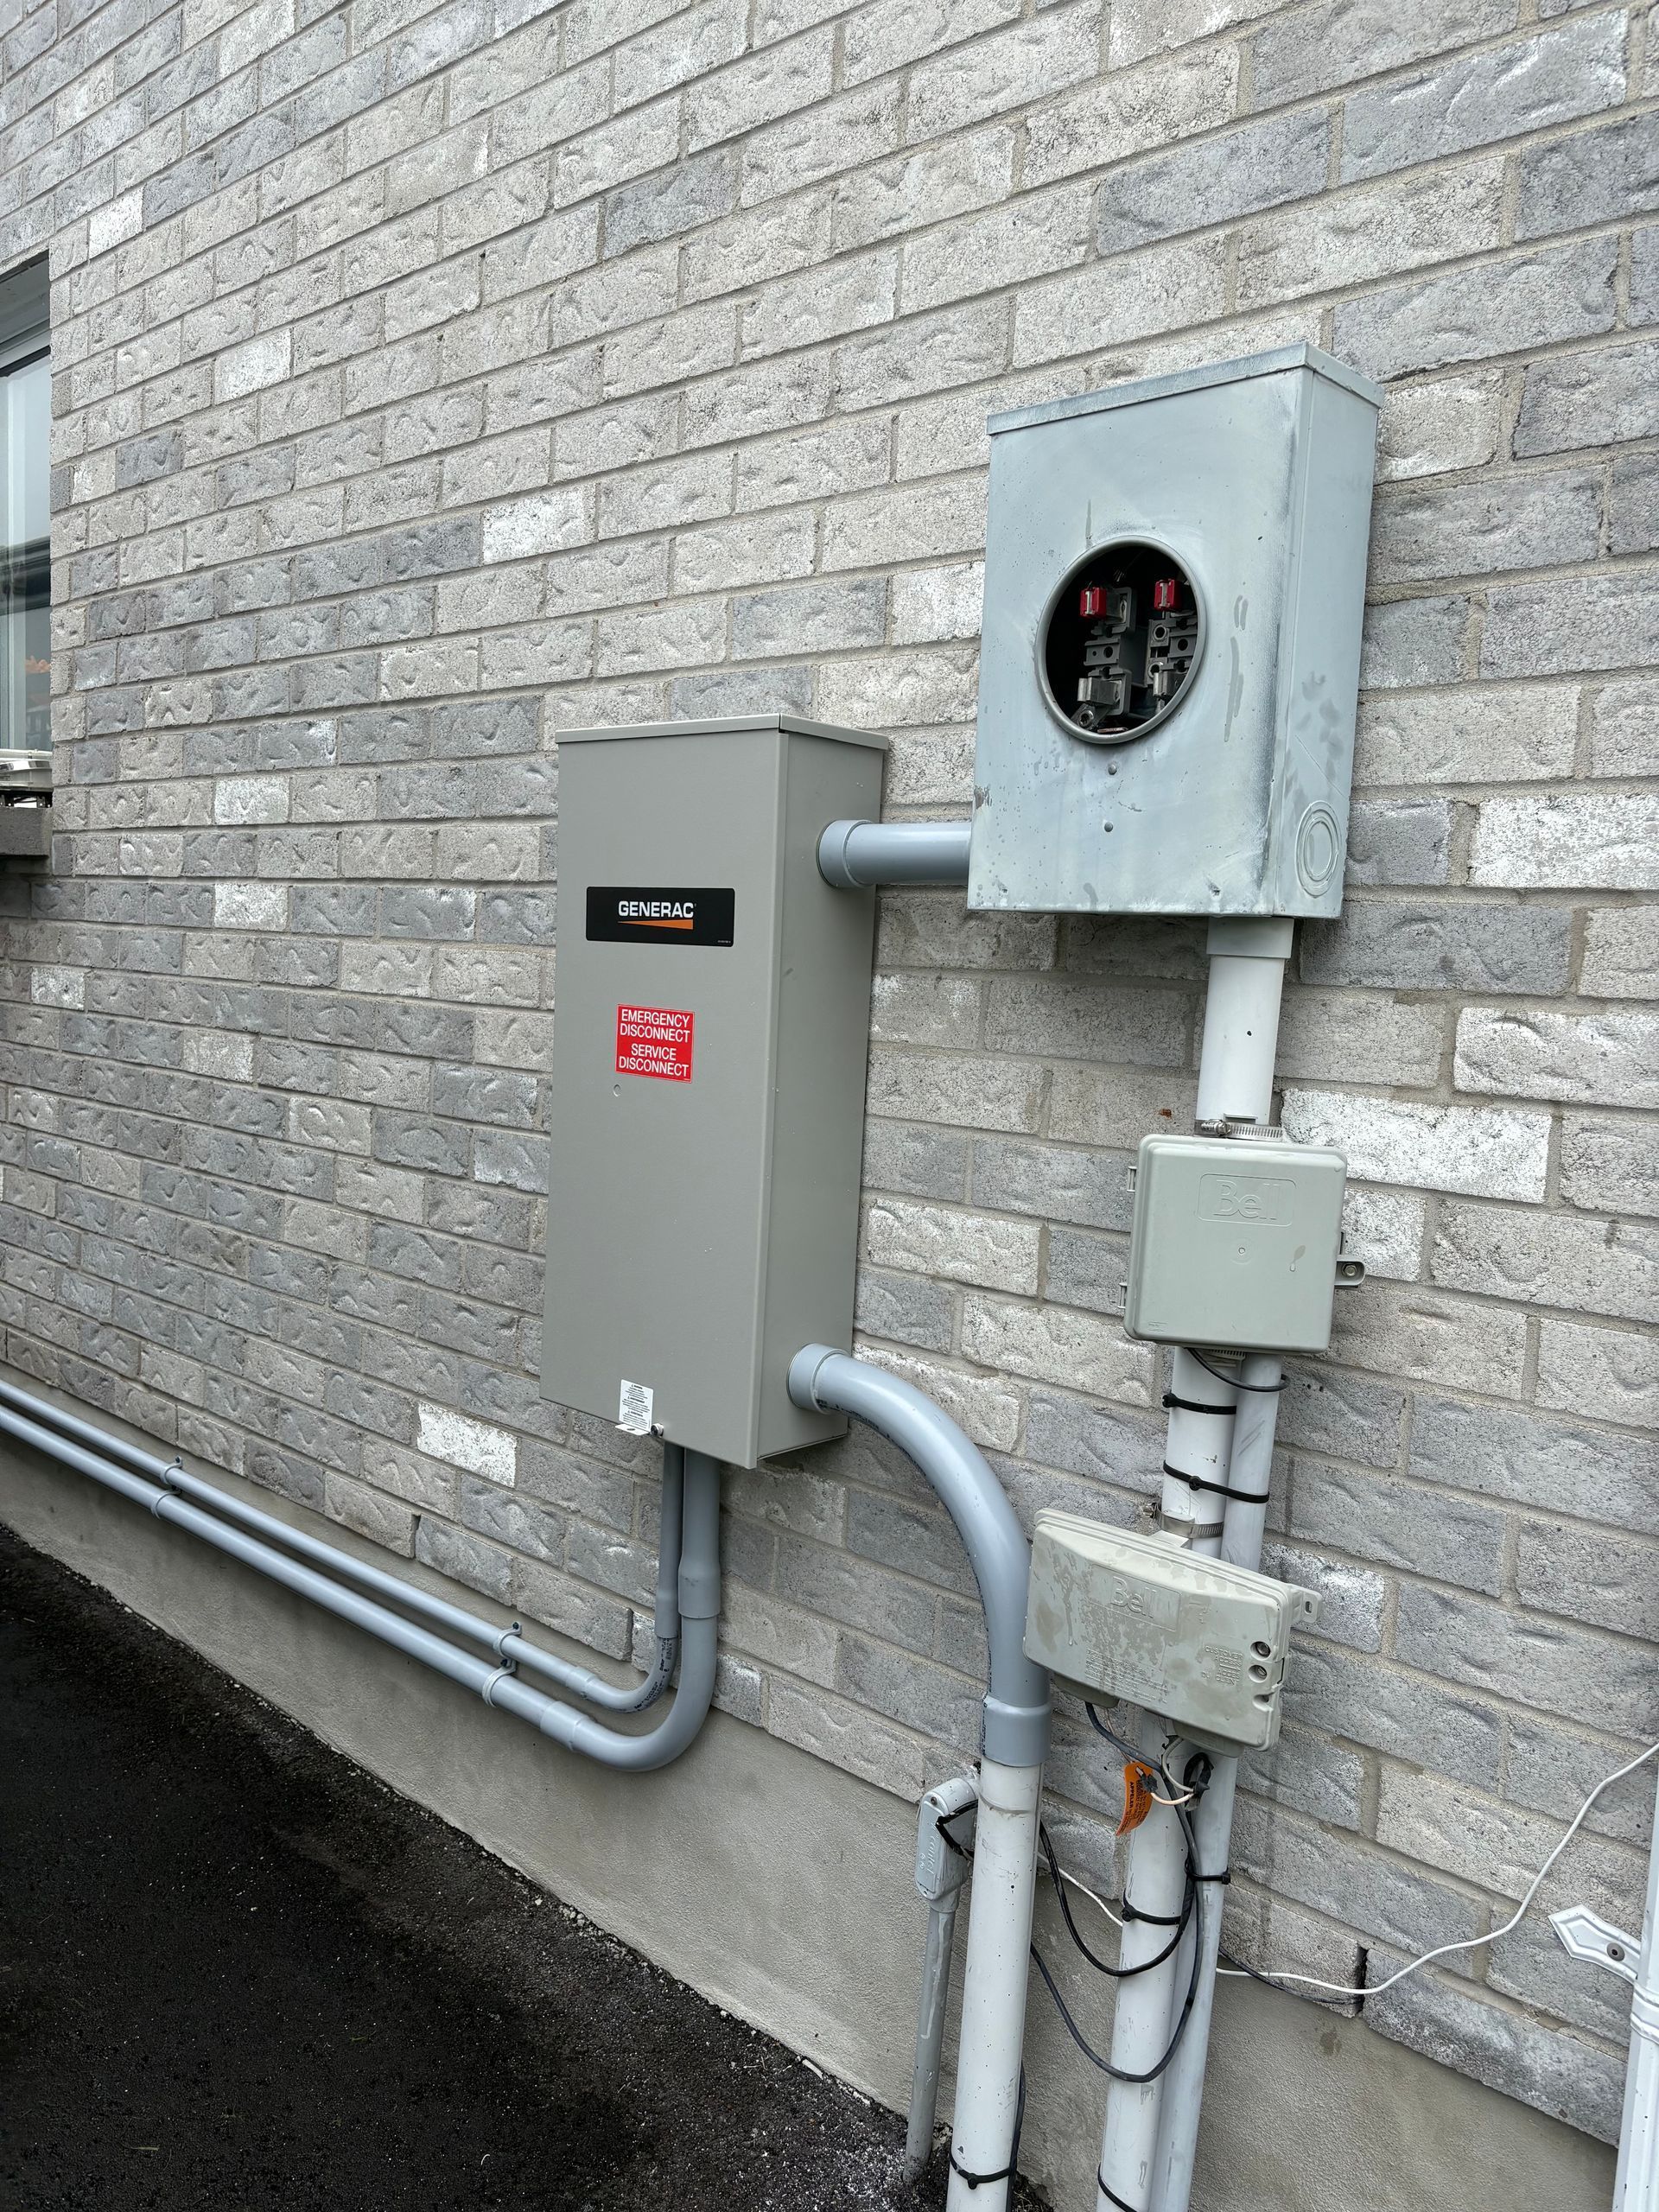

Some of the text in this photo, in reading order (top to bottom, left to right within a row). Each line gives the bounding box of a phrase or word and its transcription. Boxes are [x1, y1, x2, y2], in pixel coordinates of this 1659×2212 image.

[618, 900, 694, 918] GENERAC
[621, 1008, 690, 1028] EMERGENCY
[620, 1022, 690, 1043] DISCONNECT
[631, 1043, 677, 1061] SERVICE
[619, 1056, 690, 1077] DISCONNECT
[1213, 1179, 1280, 1220] Bell
[1110, 1576, 1157, 1618] Bell
